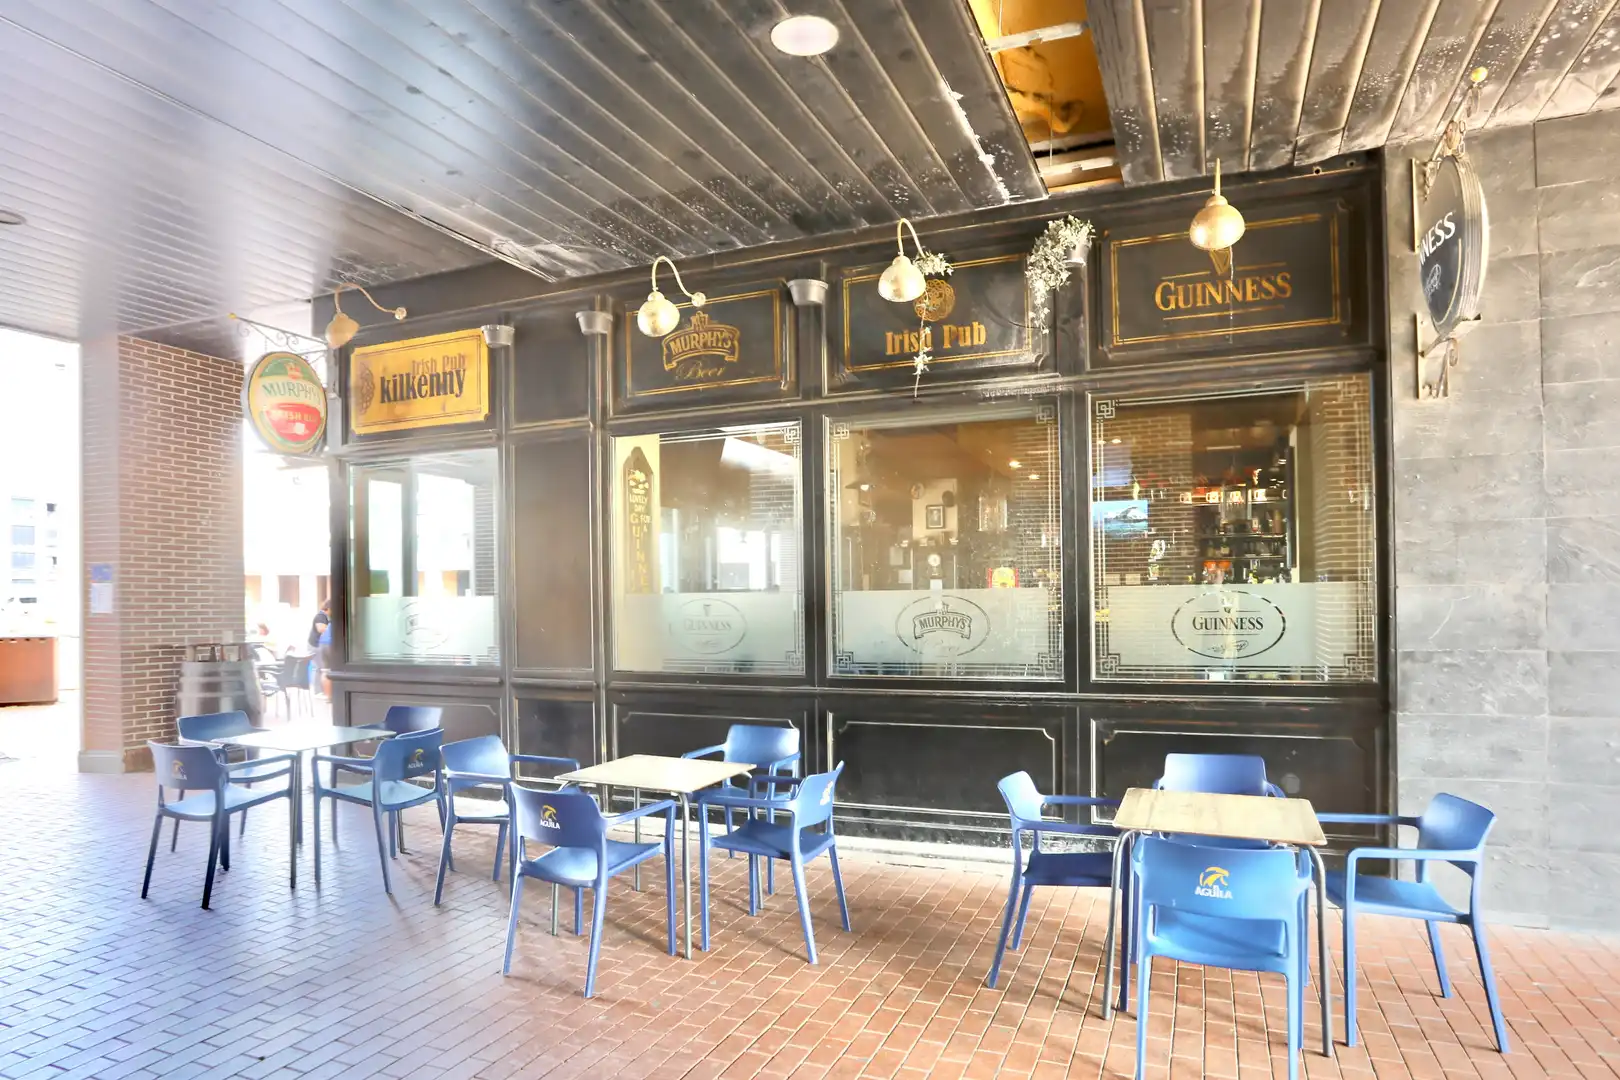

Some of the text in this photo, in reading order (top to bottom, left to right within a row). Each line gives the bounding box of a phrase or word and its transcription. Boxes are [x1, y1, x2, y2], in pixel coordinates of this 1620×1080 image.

[1155, 272, 1292, 311] GUINNESS
[942, 321, 987, 349] Pub
[380, 368, 466, 404] kilkenny
[1192, 616, 1264, 631] GUINNESS
